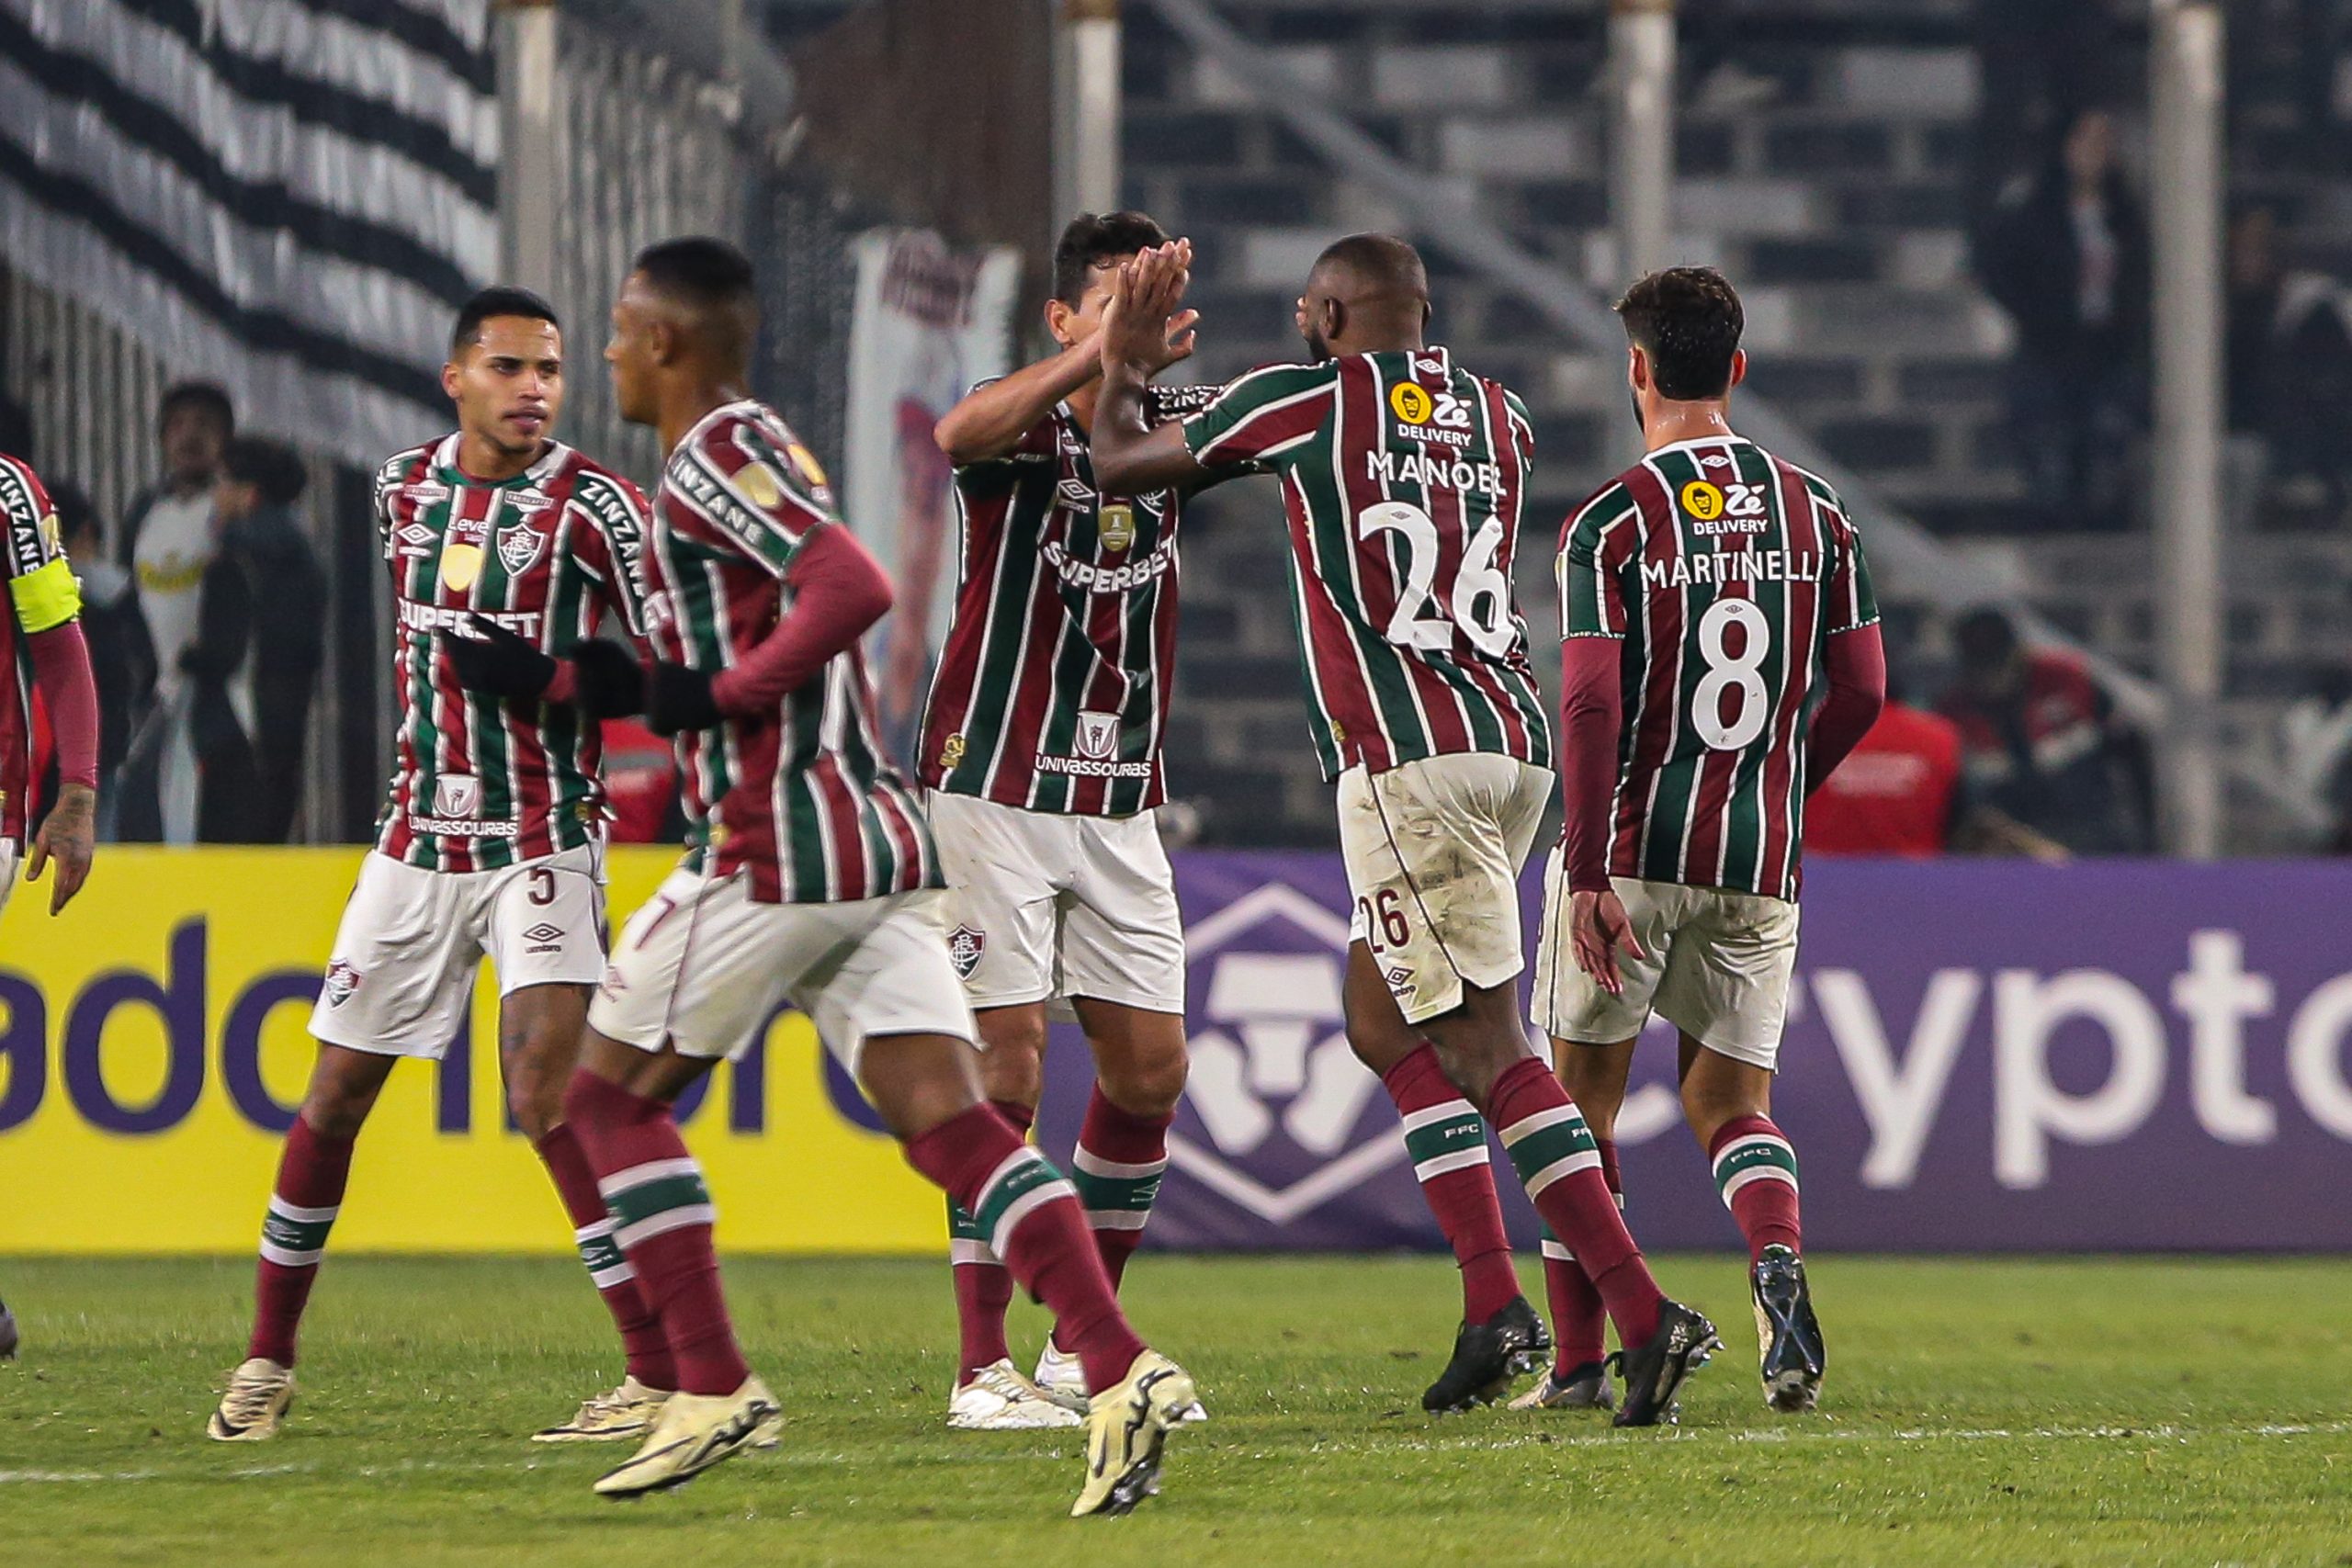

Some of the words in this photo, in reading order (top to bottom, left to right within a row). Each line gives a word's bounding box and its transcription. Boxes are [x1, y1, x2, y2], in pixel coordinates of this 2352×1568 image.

[1433, 394, 1472, 428] Zé
[1398, 424, 1473, 446] DELIVERY
[1367, 451, 1508, 496] MANOEL
[1724, 484, 1765, 516] Zé
[580, 479, 647, 598] ZINZANE
[1693, 519, 1768, 535] DELIVERY
[1043, 536, 1176, 592] SUPERBET
[1359, 502, 1516, 658] 26
[1692, 599, 1770, 750] 8
[527, 866, 557, 906] 5
[632, 895, 676, 950] 7
[1359, 888, 1409, 953] 26
[1444, 1123, 1479, 1138] FFC
